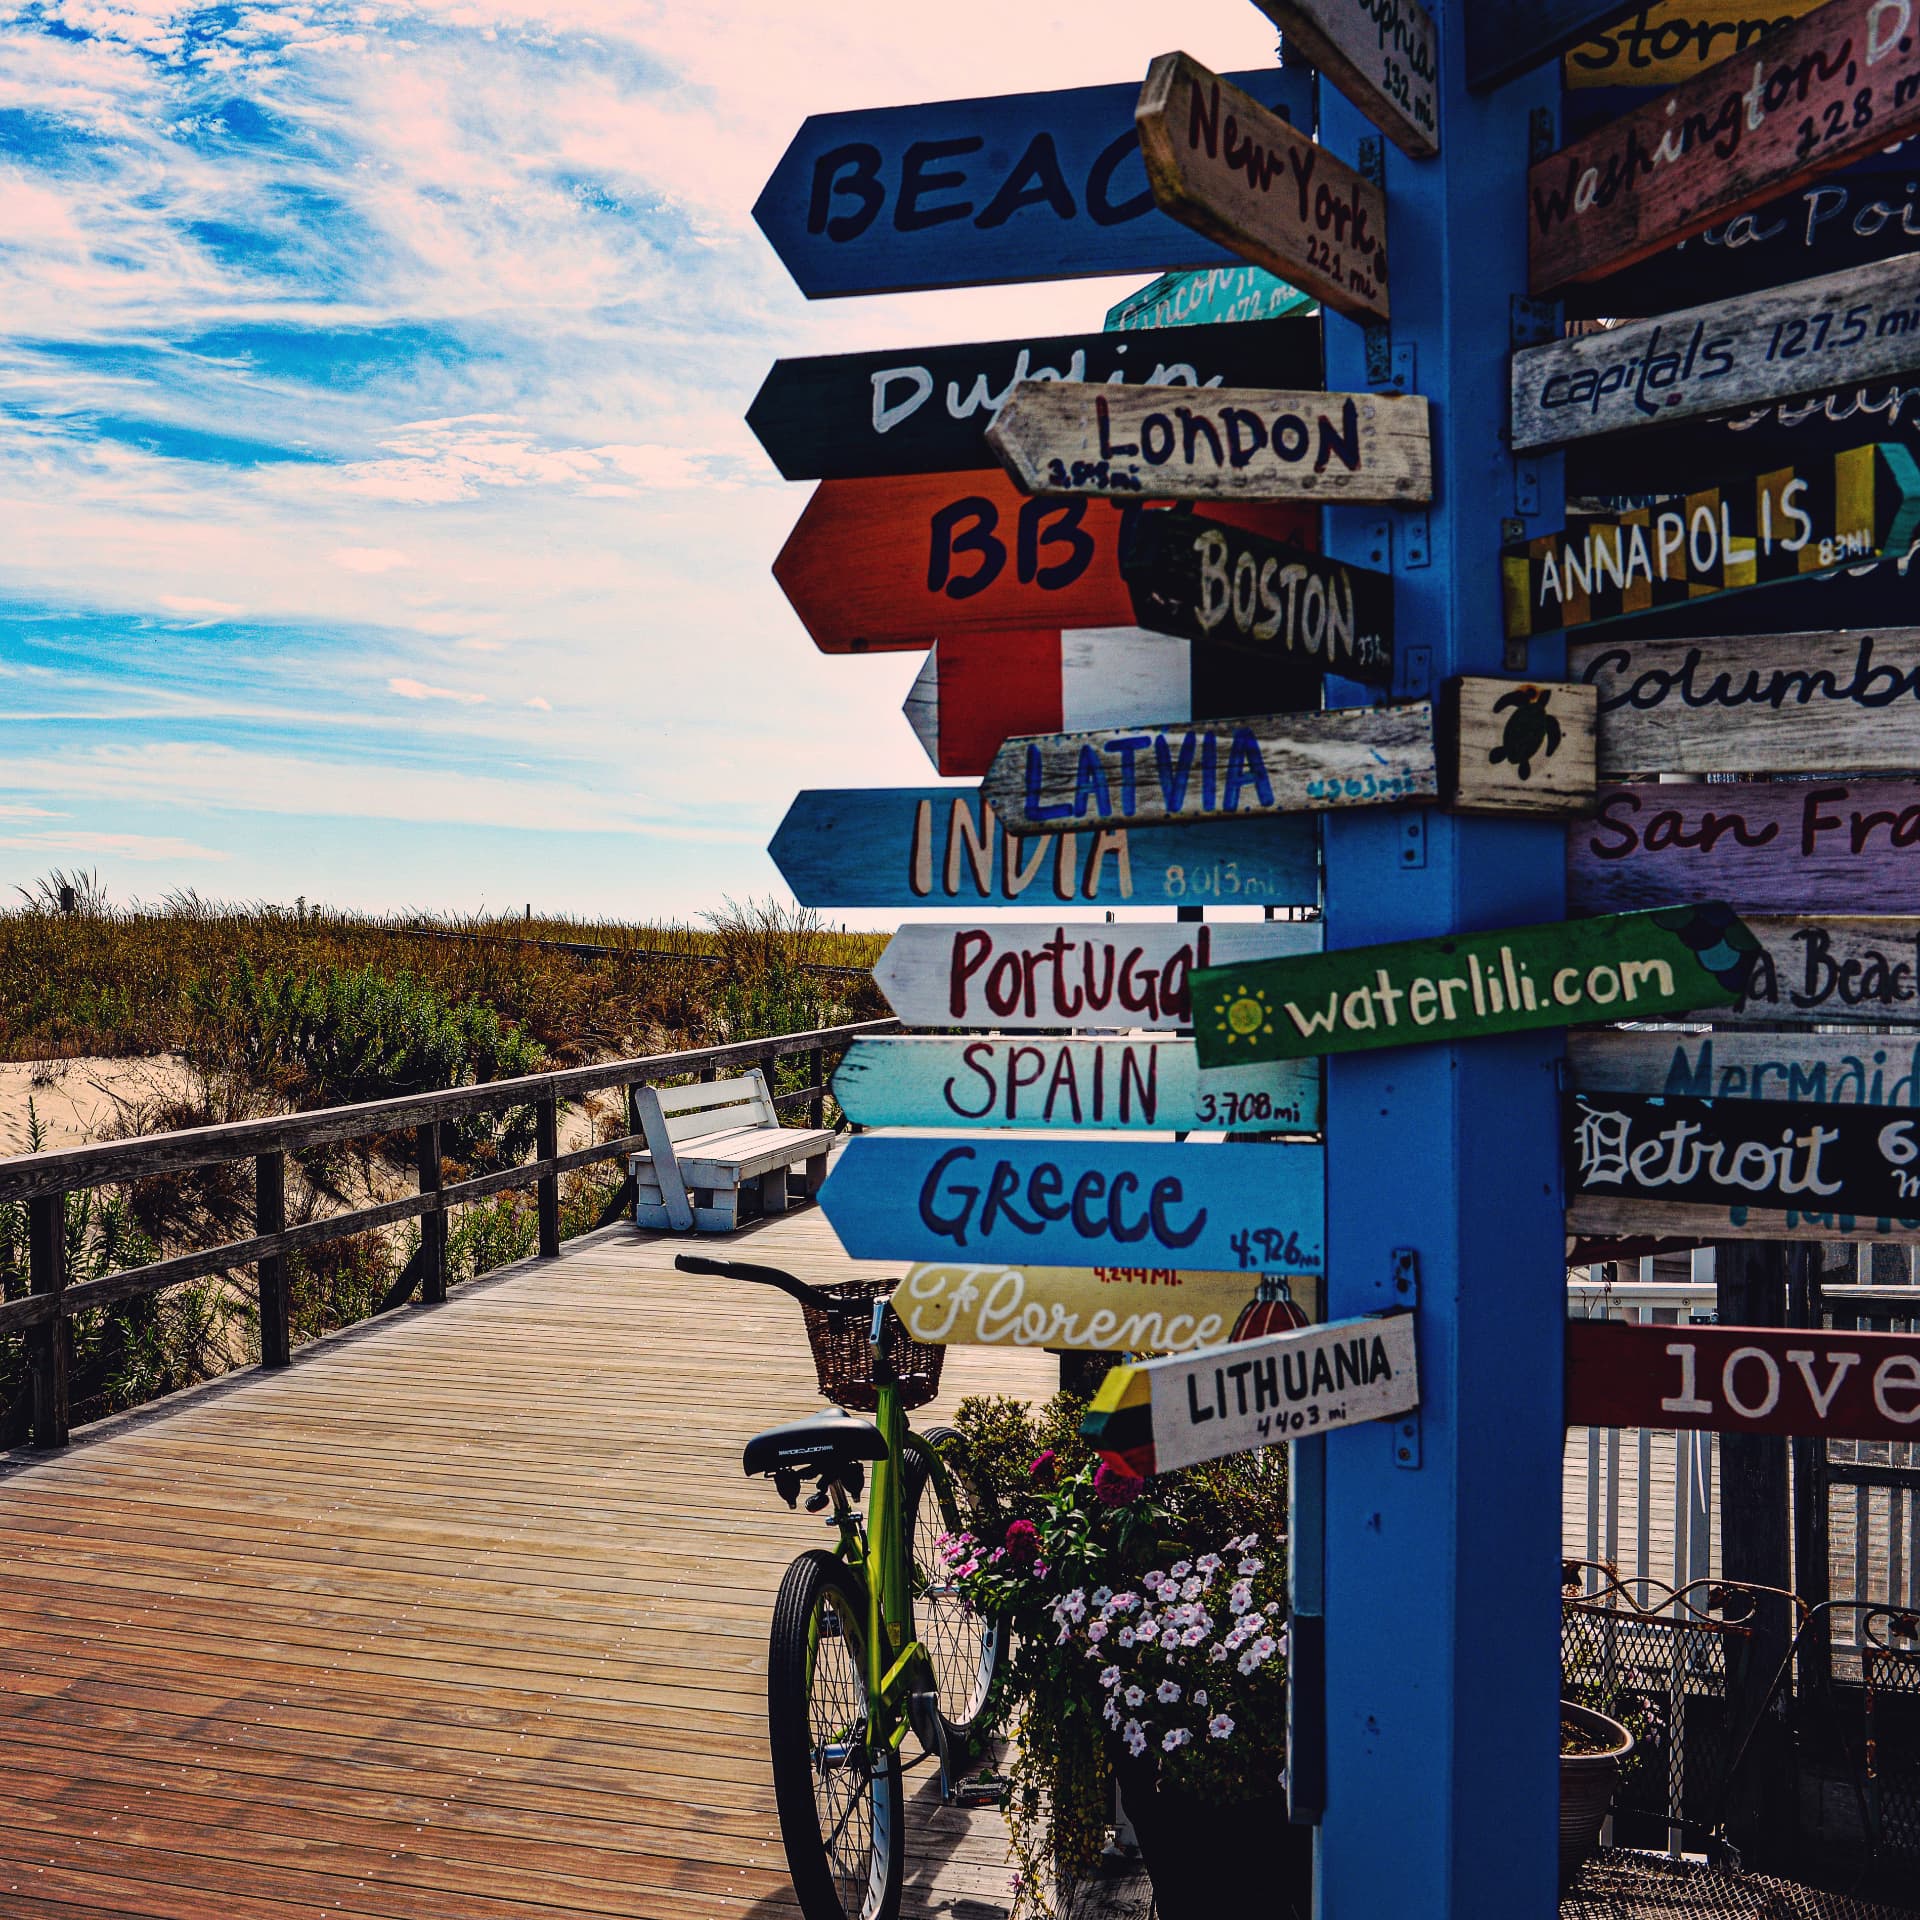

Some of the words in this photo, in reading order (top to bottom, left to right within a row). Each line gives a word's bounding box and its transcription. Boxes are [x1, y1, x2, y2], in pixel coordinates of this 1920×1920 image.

[1866, 0, 1920, 67] D.
[1383, 56, 1410, 113] 132
[1796, 88, 1873, 156] 128
[806, 122, 1180, 243] BEAC
[1189, 78, 1284, 192] New
[1290, 146, 1375, 253] York
[1307, 235, 1343, 283] 221
[1351, 263, 1377, 299] mi
[1540, 320, 1733, 415] capitals
[1766, 304, 1872, 362] 127.5
[1539, 477, 1812, 607] ANNAPOLIS
[1193, 529, 1355, 663] BOSTON
[1582, 636, 1920, 713] Columb
[1025, 727, 1275, 822] LATVIA
[909, 800, 1134, 900] INDIA
[1590, 791, 1779, 860] San
[1286, 945, 1675, 1038] waterlili.com
[1790, 926, 1920, 1008] Beac
[944, 1042, 1157, 1125] SPAIN
[1574, 1102, 1843, 1196] Detroit
[909, 1264, 1228, 1351] Florence
[1187, 1335, 1392, 1424] LITHUANIA
[1256, 1404, 1320, 1437] 4403
[1329, 1402, 1347, 1421] mi
[1661, 1342, 1920, 1424] love
